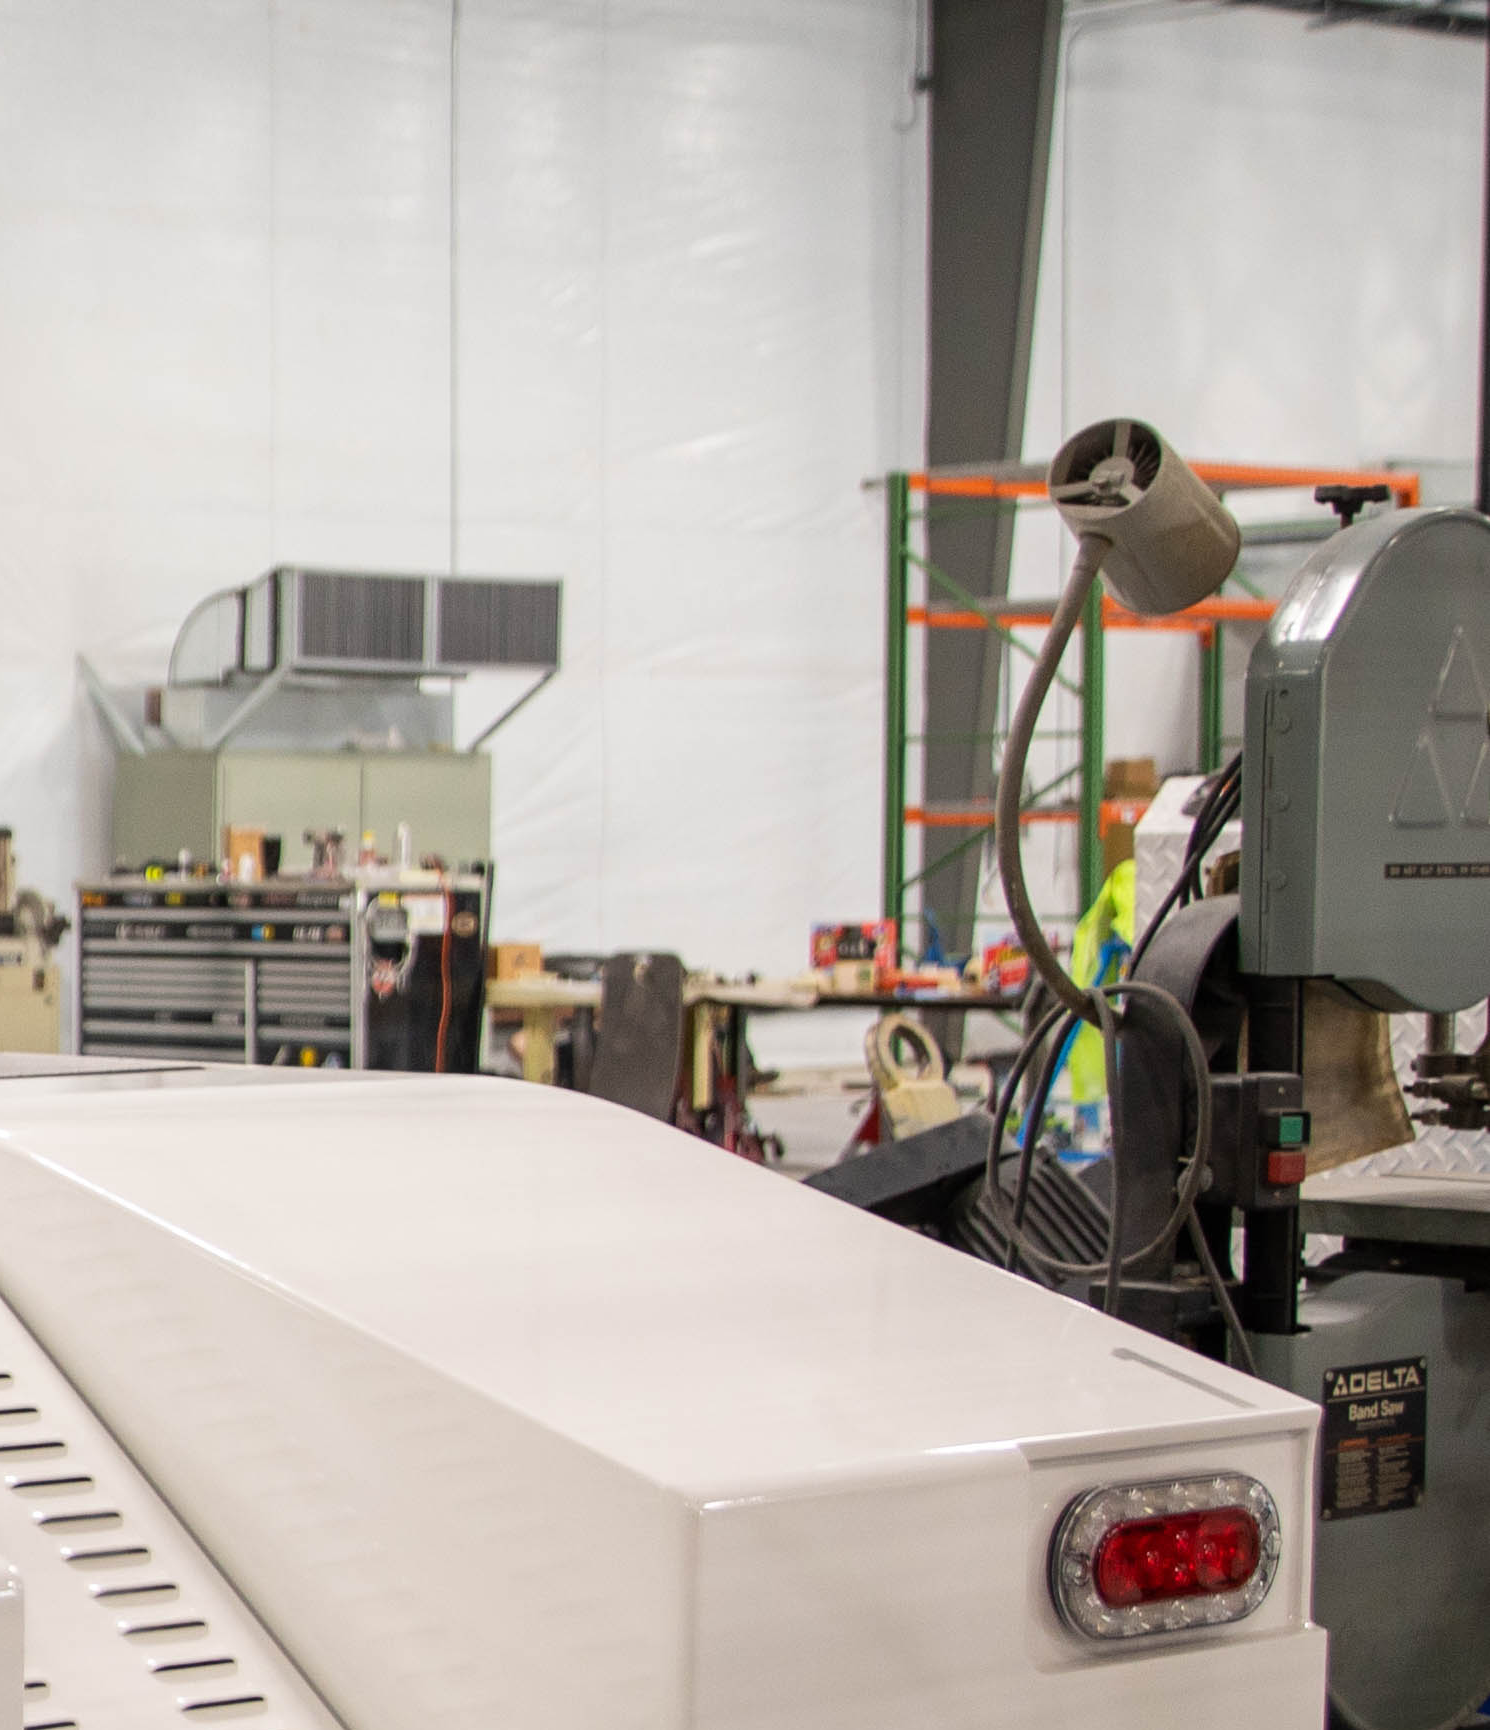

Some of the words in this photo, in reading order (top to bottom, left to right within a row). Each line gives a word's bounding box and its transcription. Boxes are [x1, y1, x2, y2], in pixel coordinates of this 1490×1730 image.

[1349, 1365, 1420, 1394] DELTA
[1348, 1400, 1378, 1422] Band
[1380, 1399, 1405, 1416] Saw
